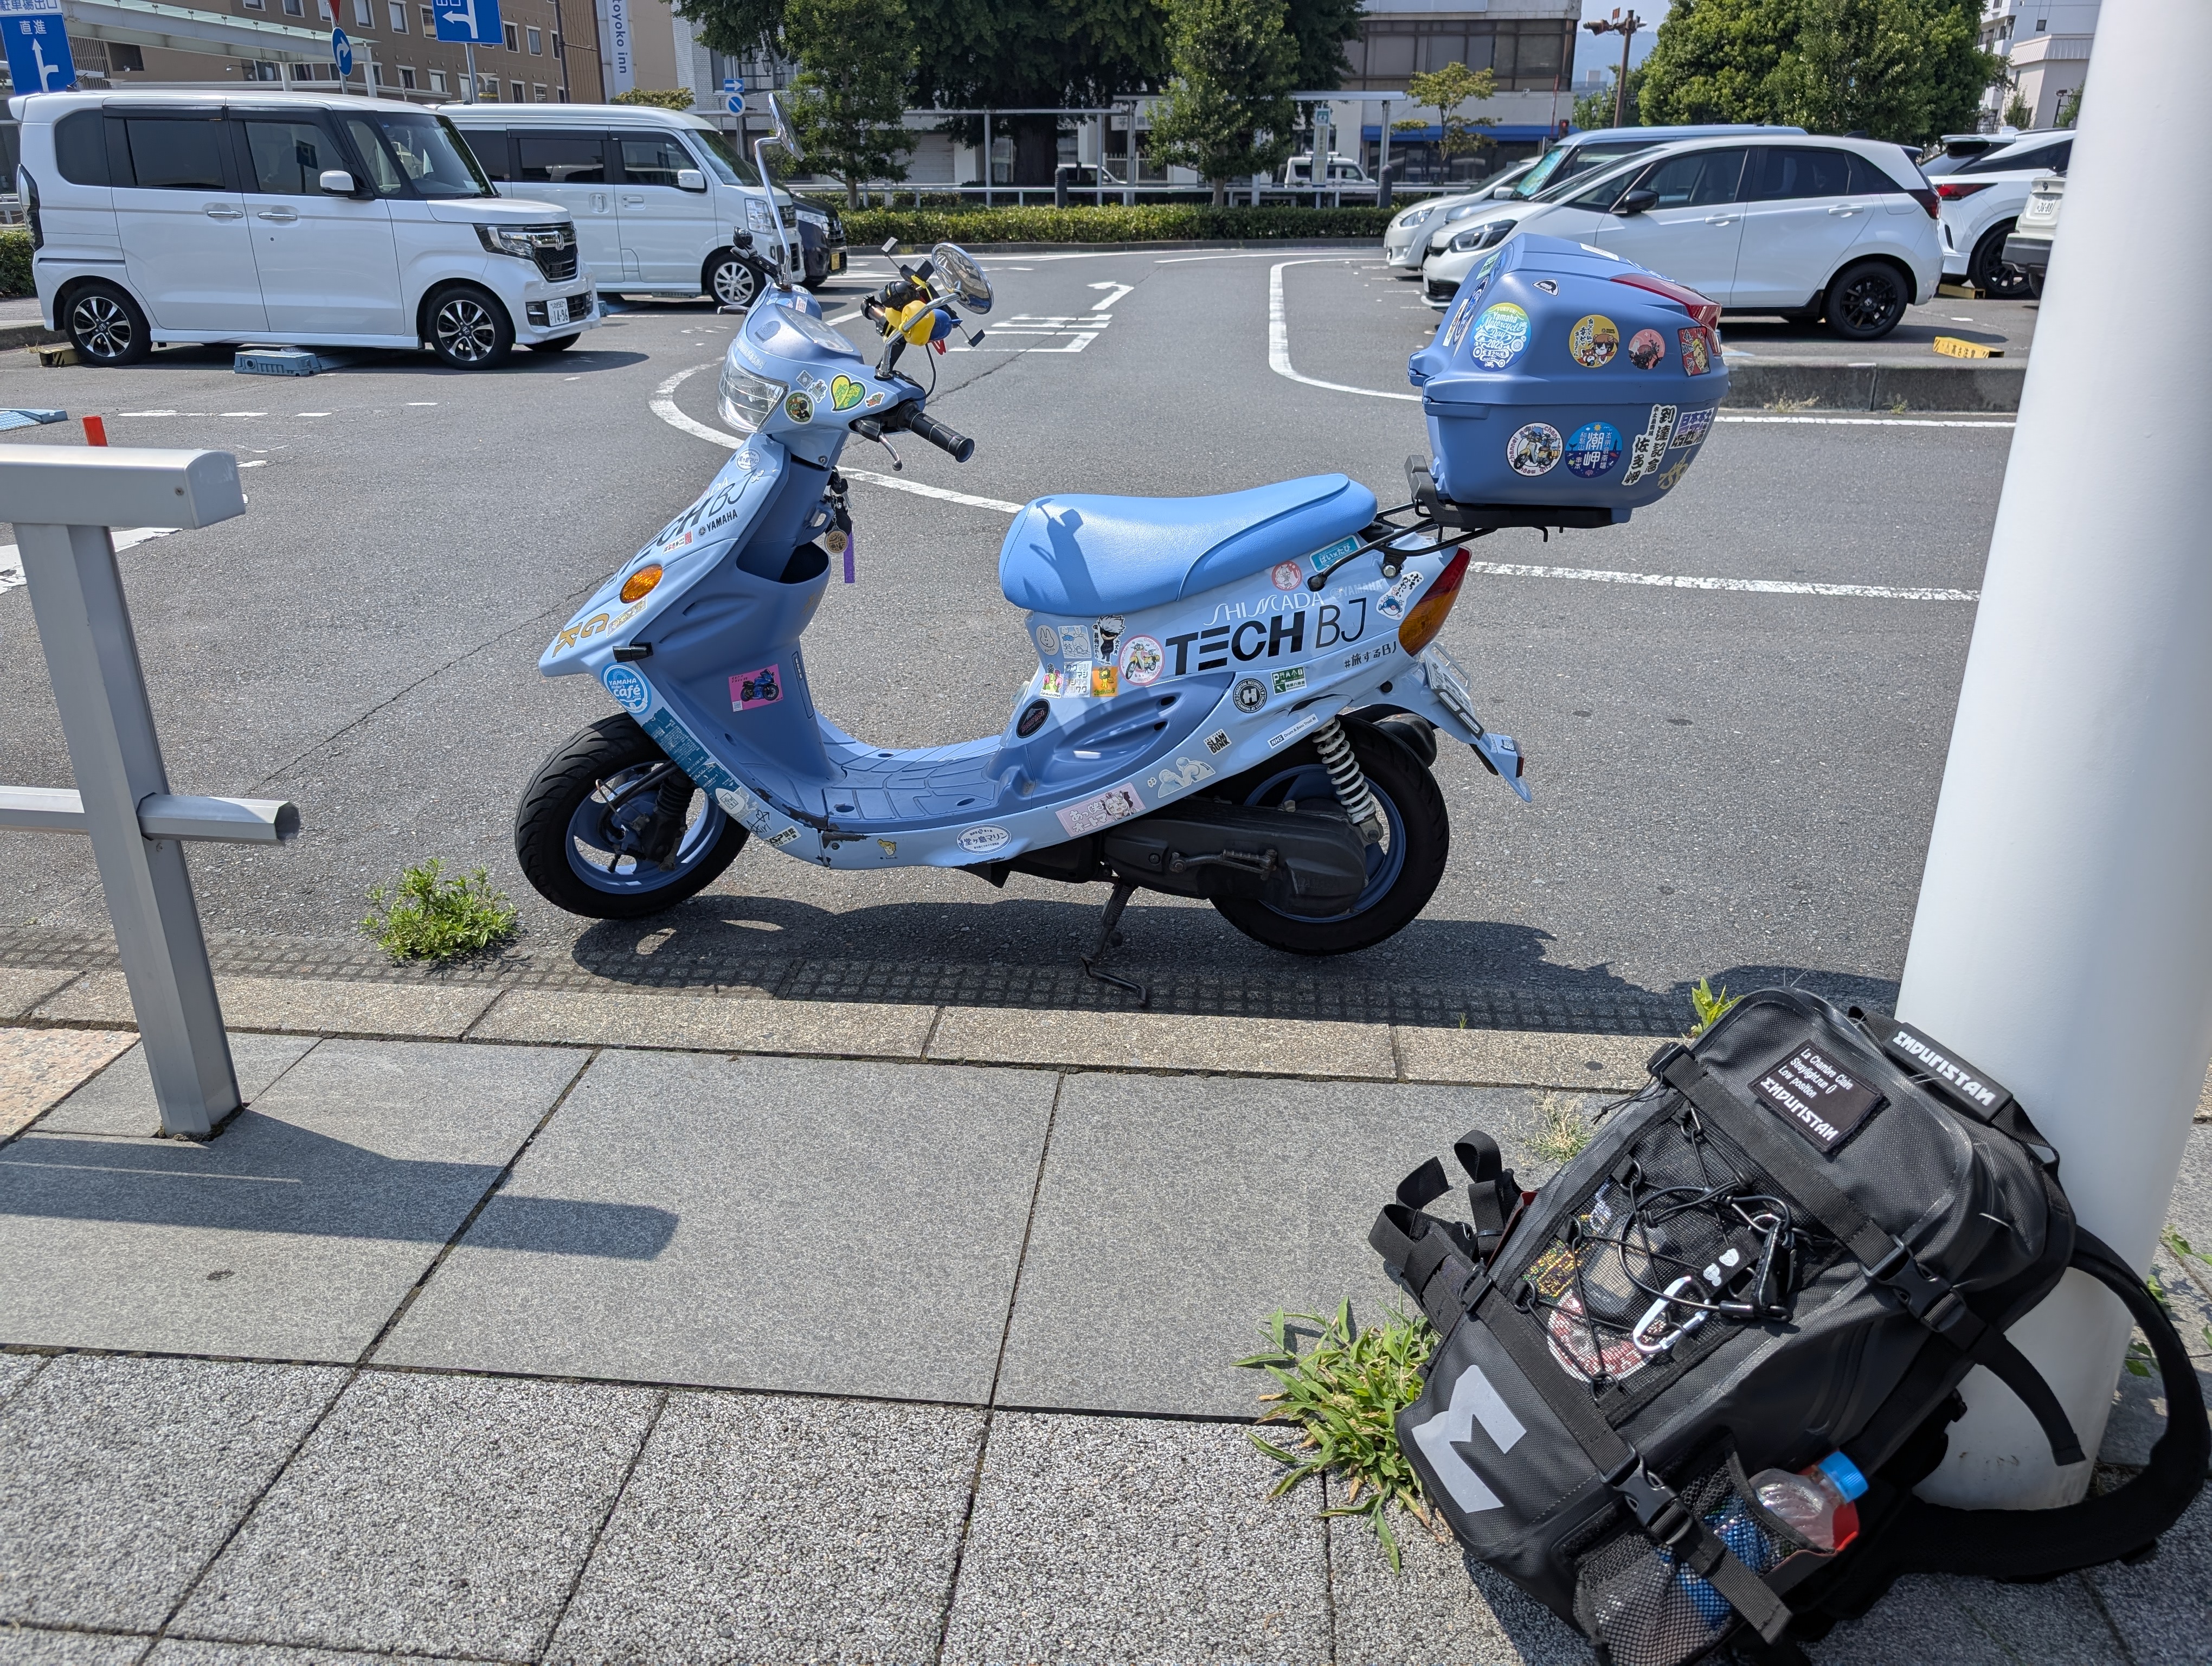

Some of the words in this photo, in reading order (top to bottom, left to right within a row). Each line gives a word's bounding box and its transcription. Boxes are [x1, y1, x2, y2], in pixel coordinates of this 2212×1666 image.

[19, 19, 48, 35] 直進
[618, 52, 628, 74] inn
[1480, 316, 1523, 332] Motorcycle
[1493, 311, 1518, 324] Yamaha
[1489, 328, 1507, 339] Day
[1488, 339, 1504, 350] 2023
[1644, 407, 1675, 473] 到達記念
[1585, 432, 1605, 469] 潮岬
[1624, 437, 1650, 484] 佐多岬
[706, 509, 738, 533] YAMAHA
[1342, 578, 1383, 597] YAMAHA
[1165, 610, 1306, 677] TECH
[1315, 597, 1367, 649] BJ
[1344, 640, 1397, 669] #旅するBJ
[608, 678, 637, 686] YAMAHA
[1236, 681, 1247, 695] HOSPITAL
[1248, 680, 1263, 690] RECORDS
[613, 684, 641, 699] café
[1206, 732, 1227, 748] SLAM
[1271, 735, 1283, 746] NHS
[1283, 729, 1294, 738] Drum
[1210, 740, 1231, 754] DUNK
[1072, 812, 1108, 833] オートマ
[963, 832, 1007, 846] 堂ヶ島マリン
[1800, 1047, 1811, 1060] La
[1809, 1055, 1837, 1078] Chambre
[1835, 1074, 1854, 1090] Claire
[1777, 1065, 1795, 1080] Low
[1789, 1078, 1818, 1099] position
